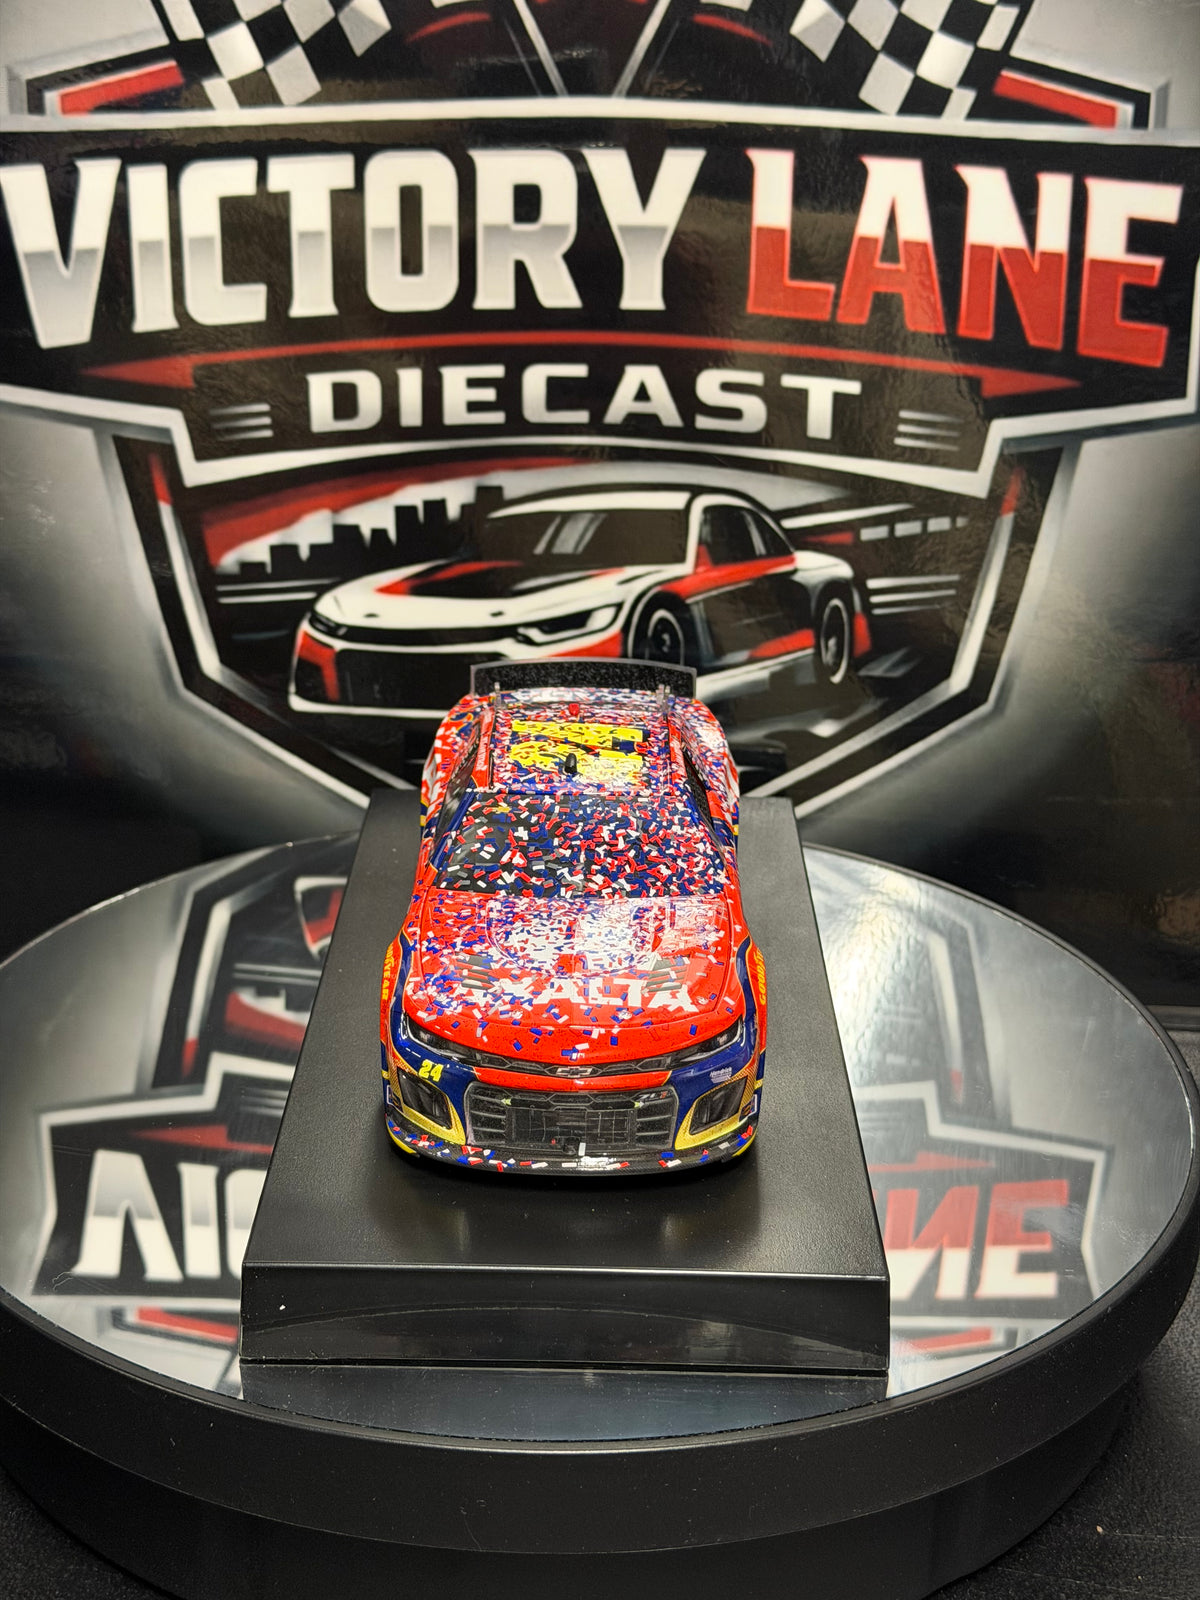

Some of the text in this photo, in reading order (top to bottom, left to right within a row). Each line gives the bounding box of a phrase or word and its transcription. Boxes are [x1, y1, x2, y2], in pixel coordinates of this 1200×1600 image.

[0, 147, 1183, 367] VICTORY LANE
[306, 363, 862, 440] DIECAST
[418, 1058, 445, 1082] 24
